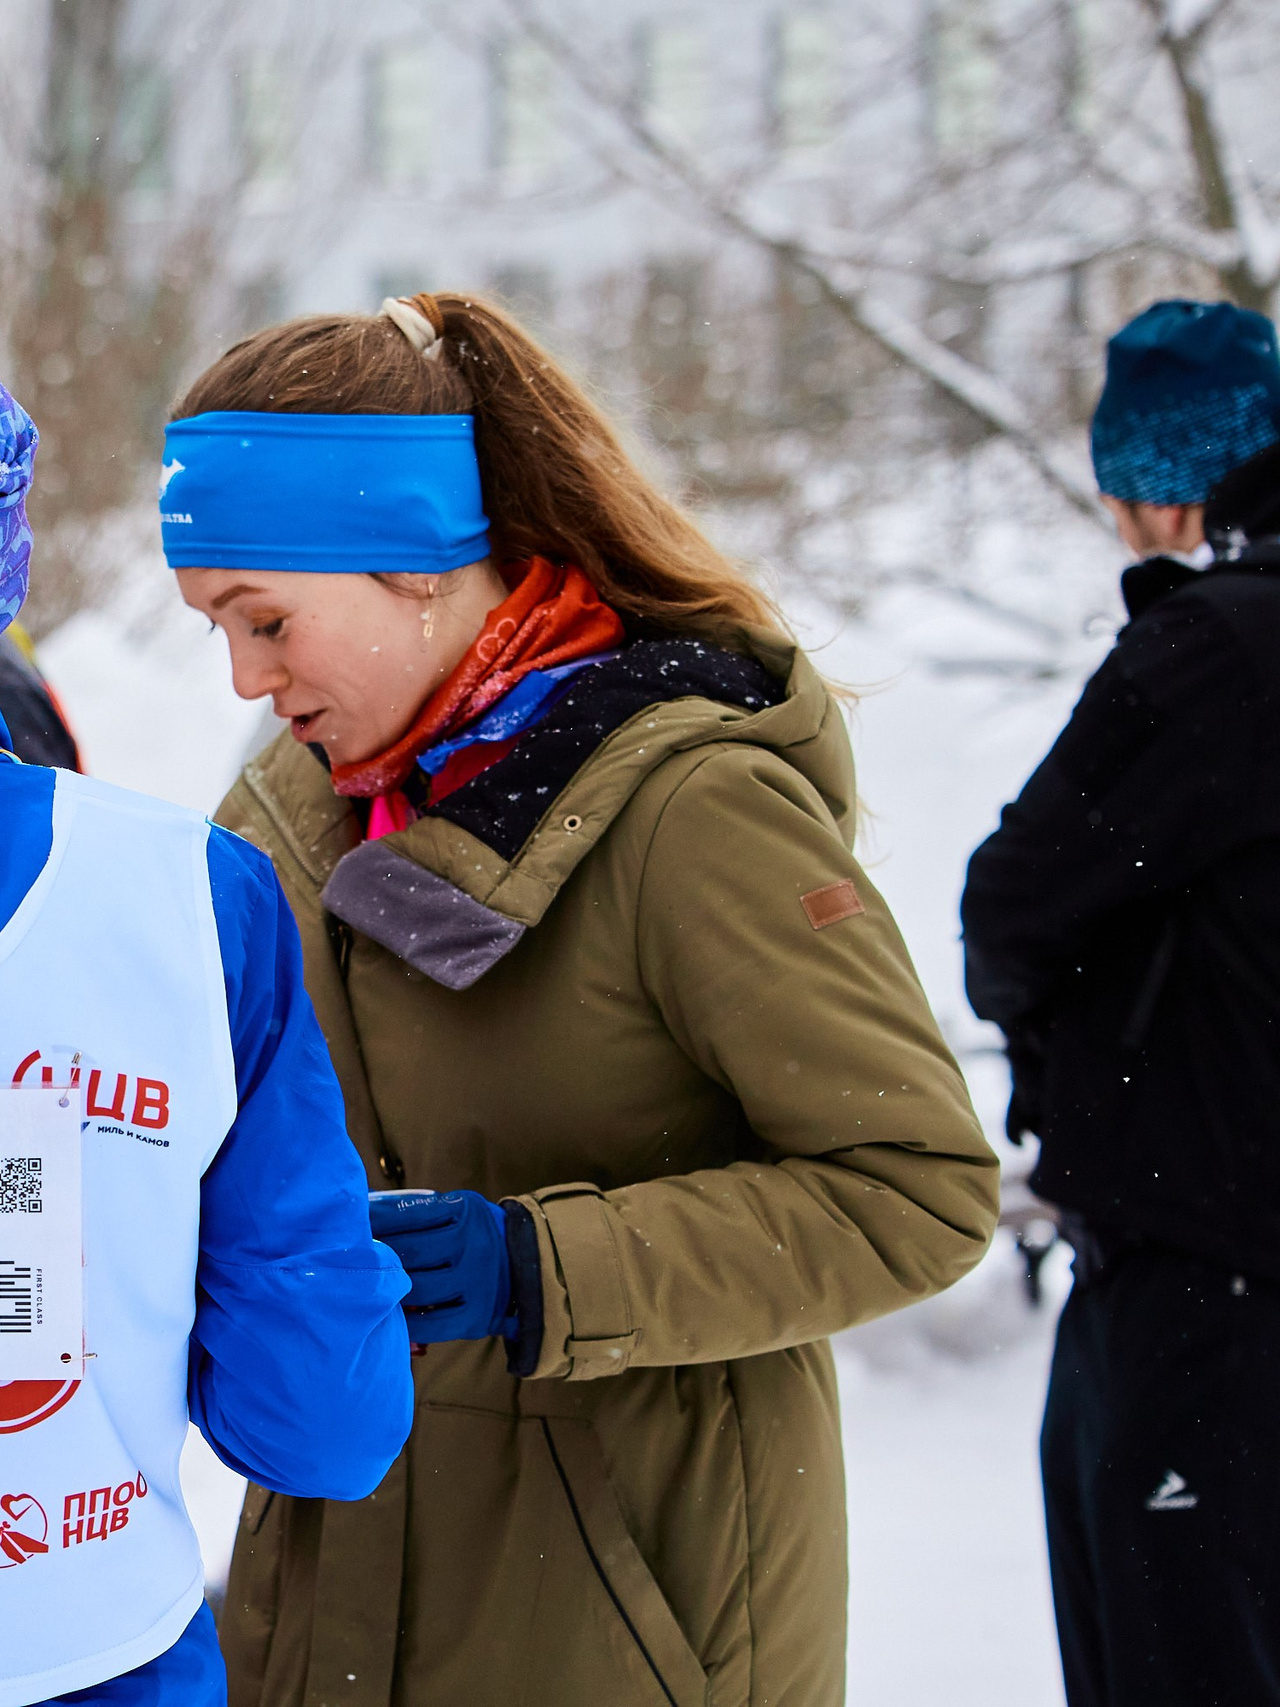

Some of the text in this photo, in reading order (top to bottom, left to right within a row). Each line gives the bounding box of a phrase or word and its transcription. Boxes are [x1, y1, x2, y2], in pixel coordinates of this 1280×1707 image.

[97, 1126, 170, 1148] МИЛЬ И КАМОВ
[35, 1268, 43, 1293] FIRST
[62, 1507, 130, 1549] НЦВ
